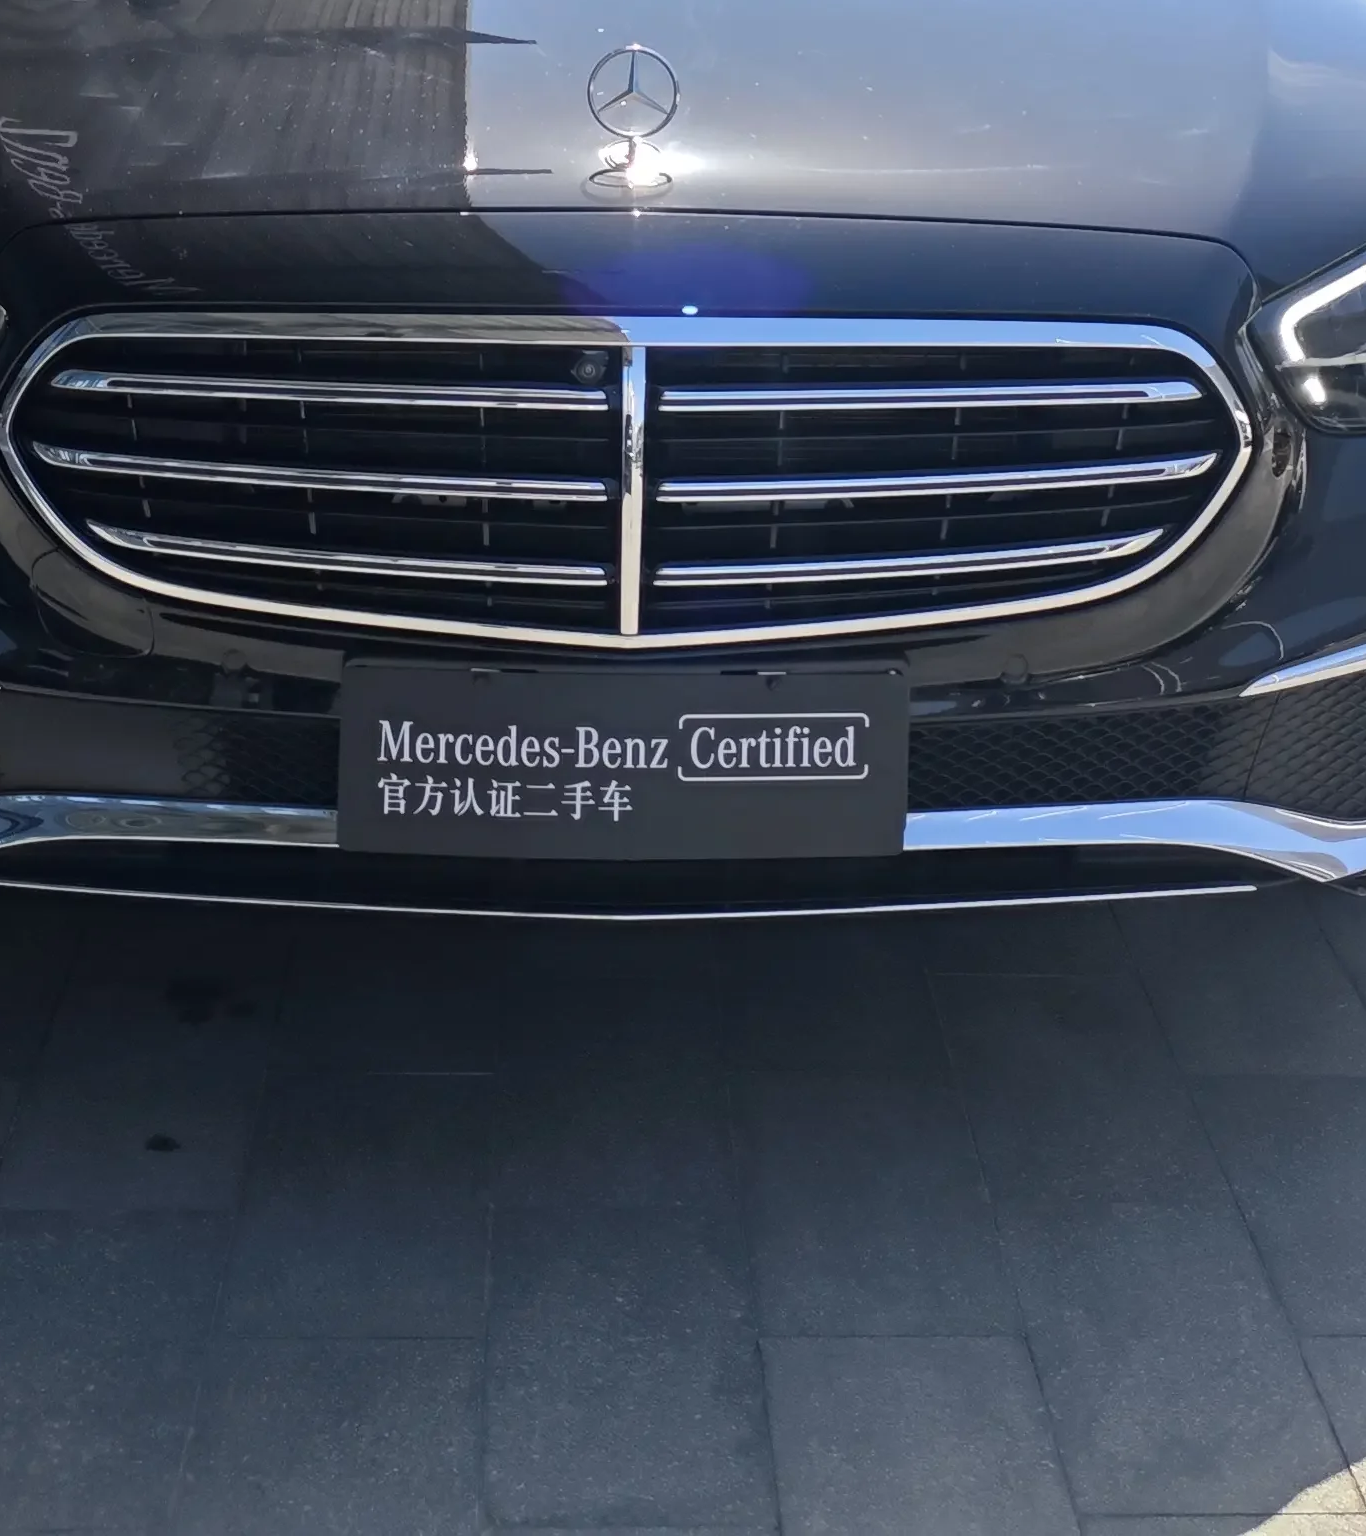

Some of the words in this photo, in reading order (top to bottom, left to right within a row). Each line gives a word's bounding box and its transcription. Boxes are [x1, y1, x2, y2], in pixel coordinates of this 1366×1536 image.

[377, 719, 669, 770] Mercedes-Benz
[689, 724, 857, 769] Certified
[377, 772, 634, 822] 官方认证二手车
